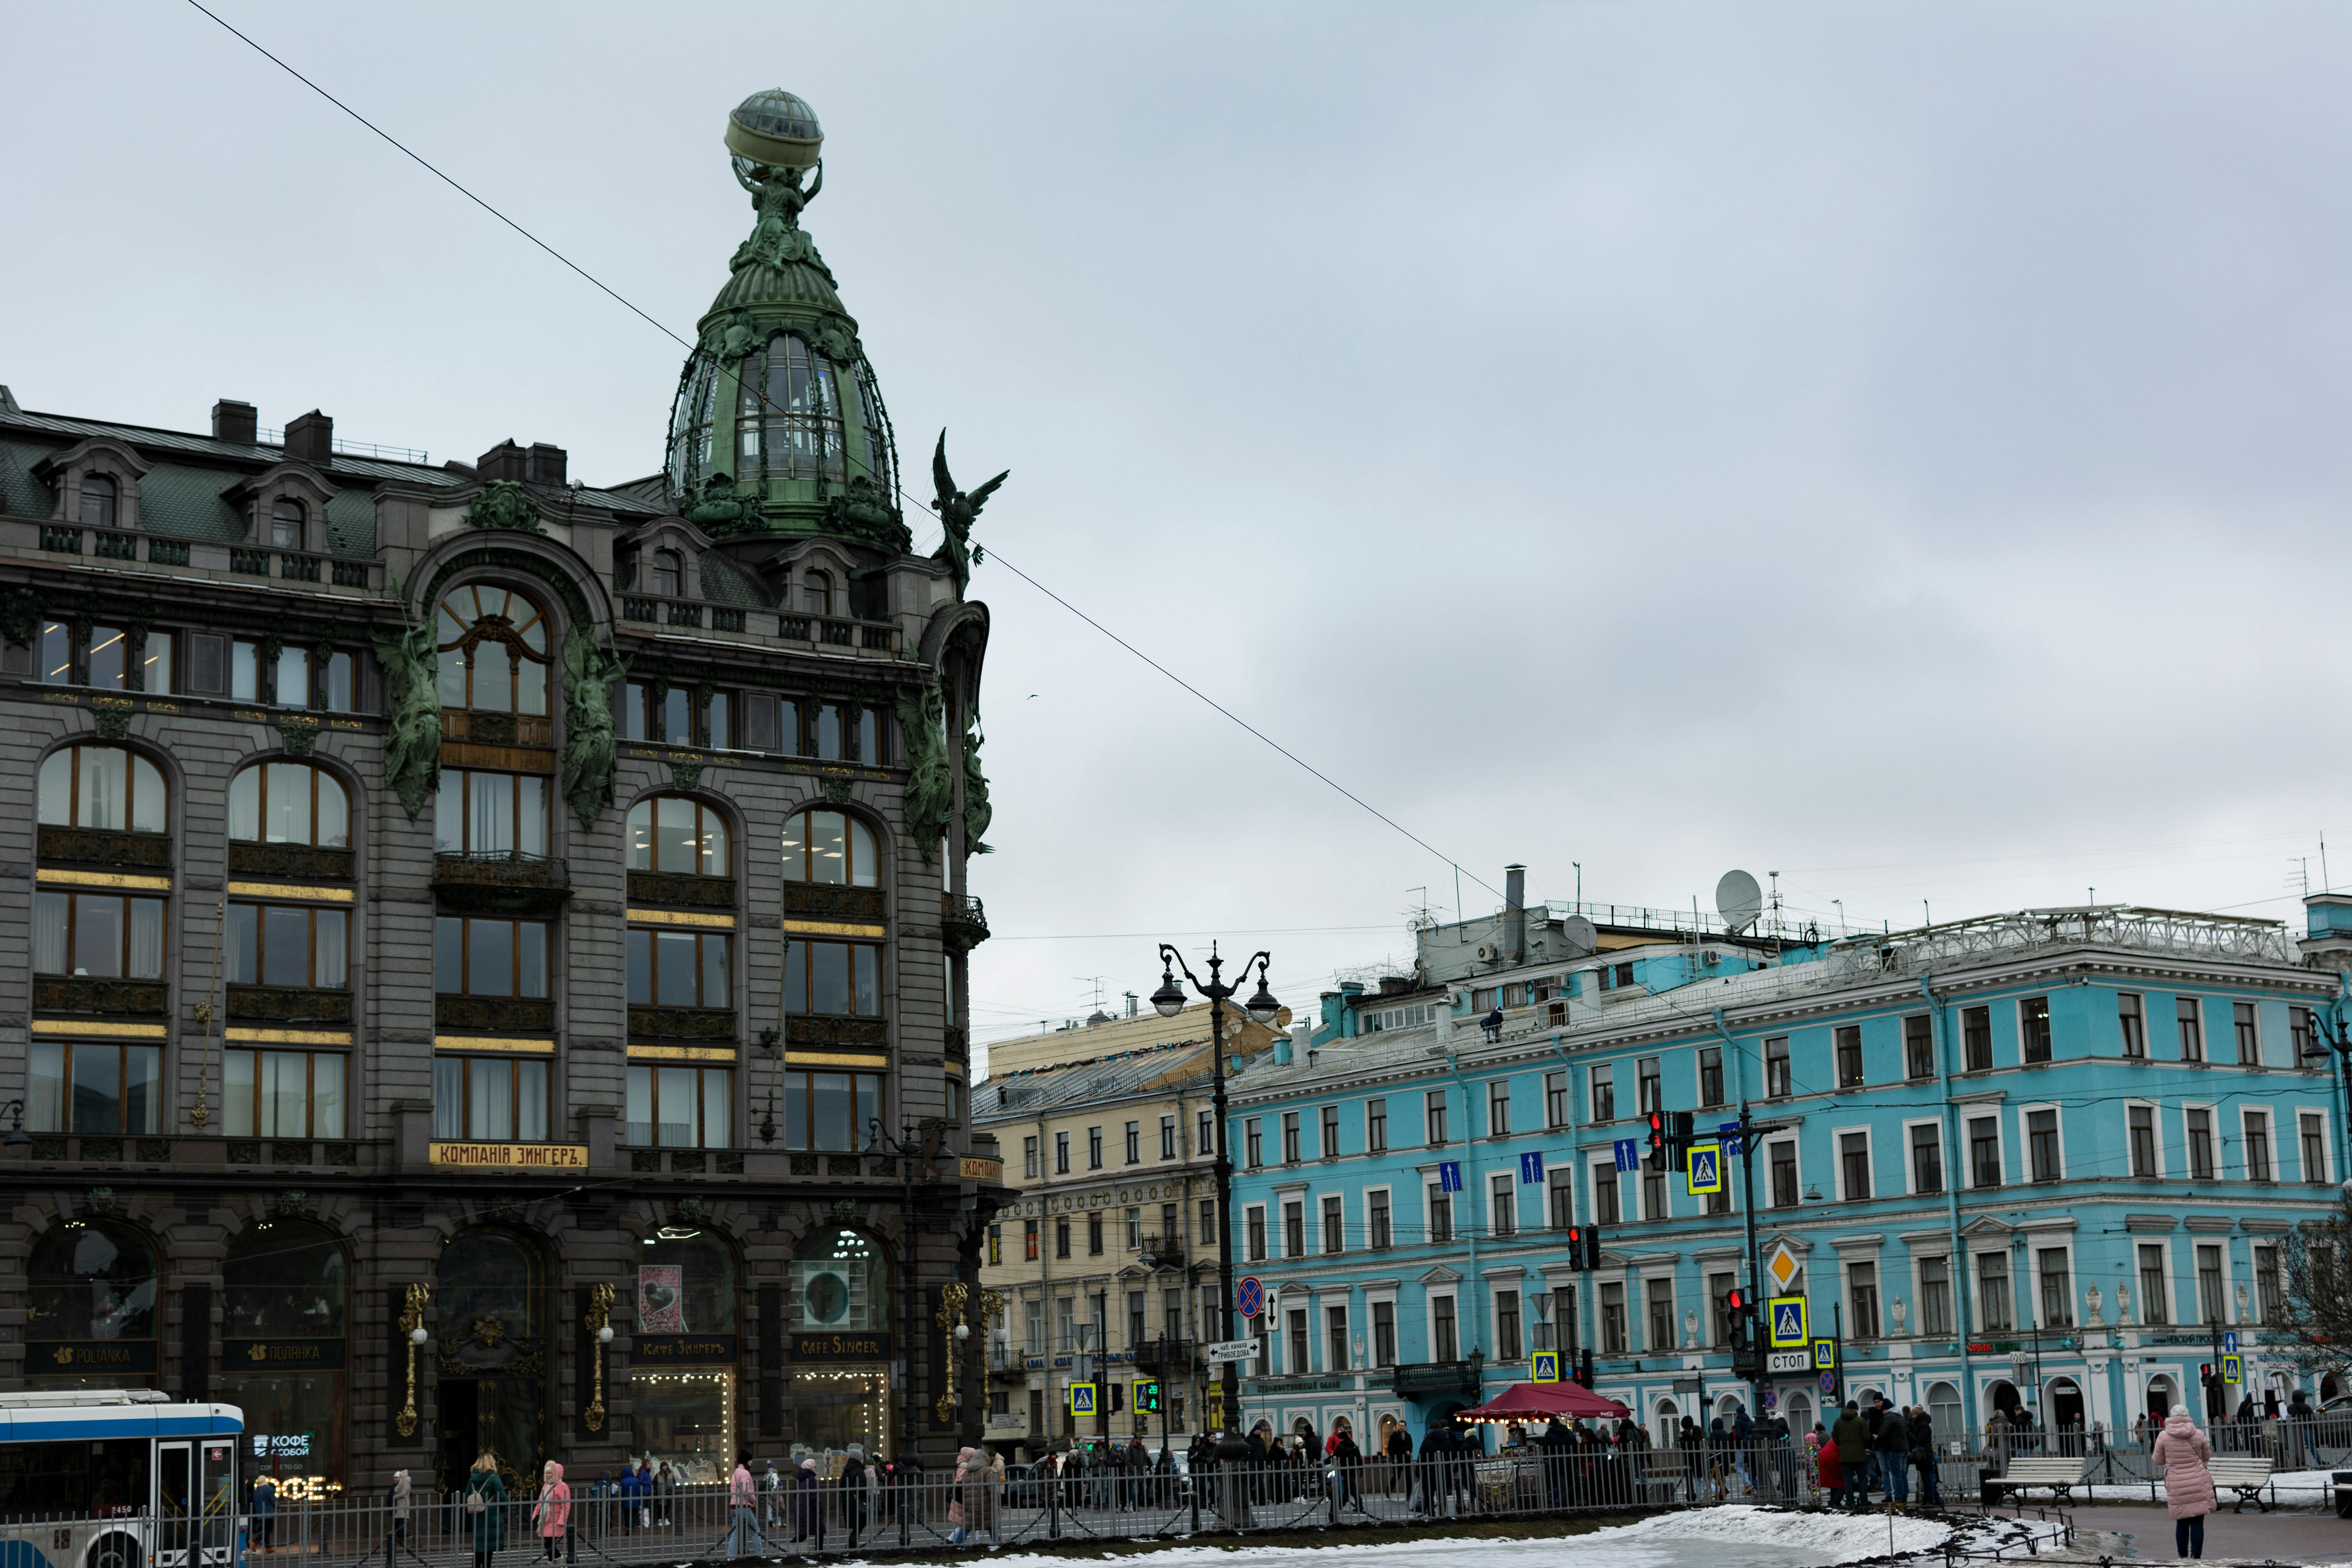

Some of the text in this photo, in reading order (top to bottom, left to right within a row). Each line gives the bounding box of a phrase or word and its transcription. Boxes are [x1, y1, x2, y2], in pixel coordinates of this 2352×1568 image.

[440, 1145, 510, 1163] КОМПАНІЯ
[2167, 1334, 2195, 1344] НЕВСКИЙ
[269, 1346, 320, 1360] ПОЛЯНКА
[1969, 1343, 1992, 1352] ОРАНЖ
[77, 1348, 131, 1363] POLIANKA
[1218, 1349, 1250, 1359] ГРИБОЕДОВА
[1027, 1359, 1044, 1368] АВИА
[1773, 1355, 1804, 1368] СТОП
[271, 1435, 309, 1447] КОФЕ
[278, 1446, 309, 1456] СОБОЙ
[253, 1475, 326, 1500] ОФЕ
